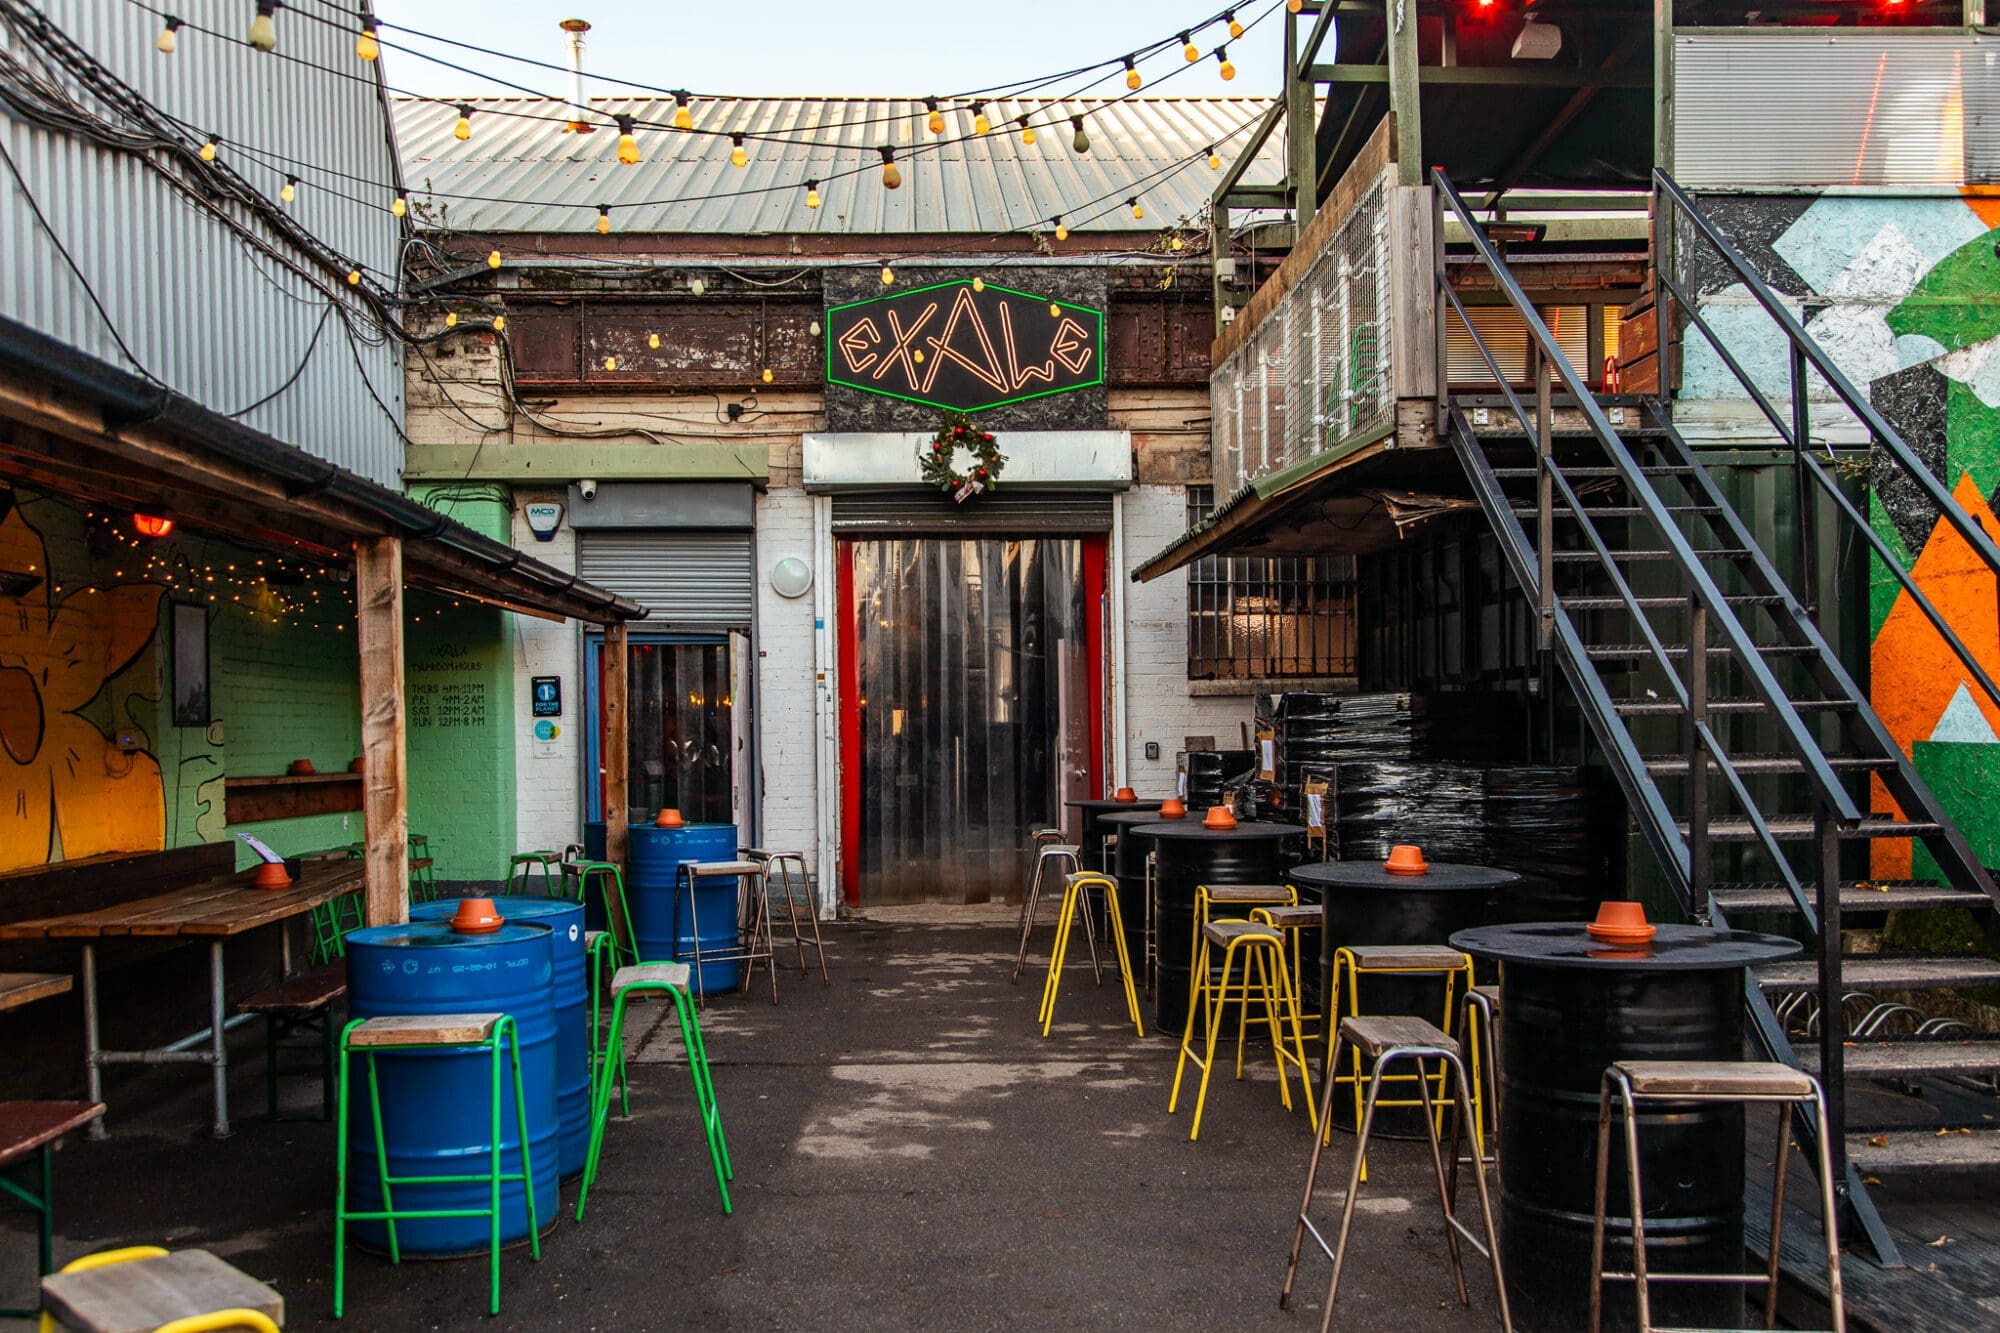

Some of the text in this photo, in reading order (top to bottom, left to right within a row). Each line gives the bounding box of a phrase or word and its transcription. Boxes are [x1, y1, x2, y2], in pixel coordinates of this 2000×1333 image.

[839, 287, 1092, 393] EXALE
[411, 684, 439, 694] THURS
[411, 705, 431, 716] SAT
[411, 716, 432, 727] SUN
